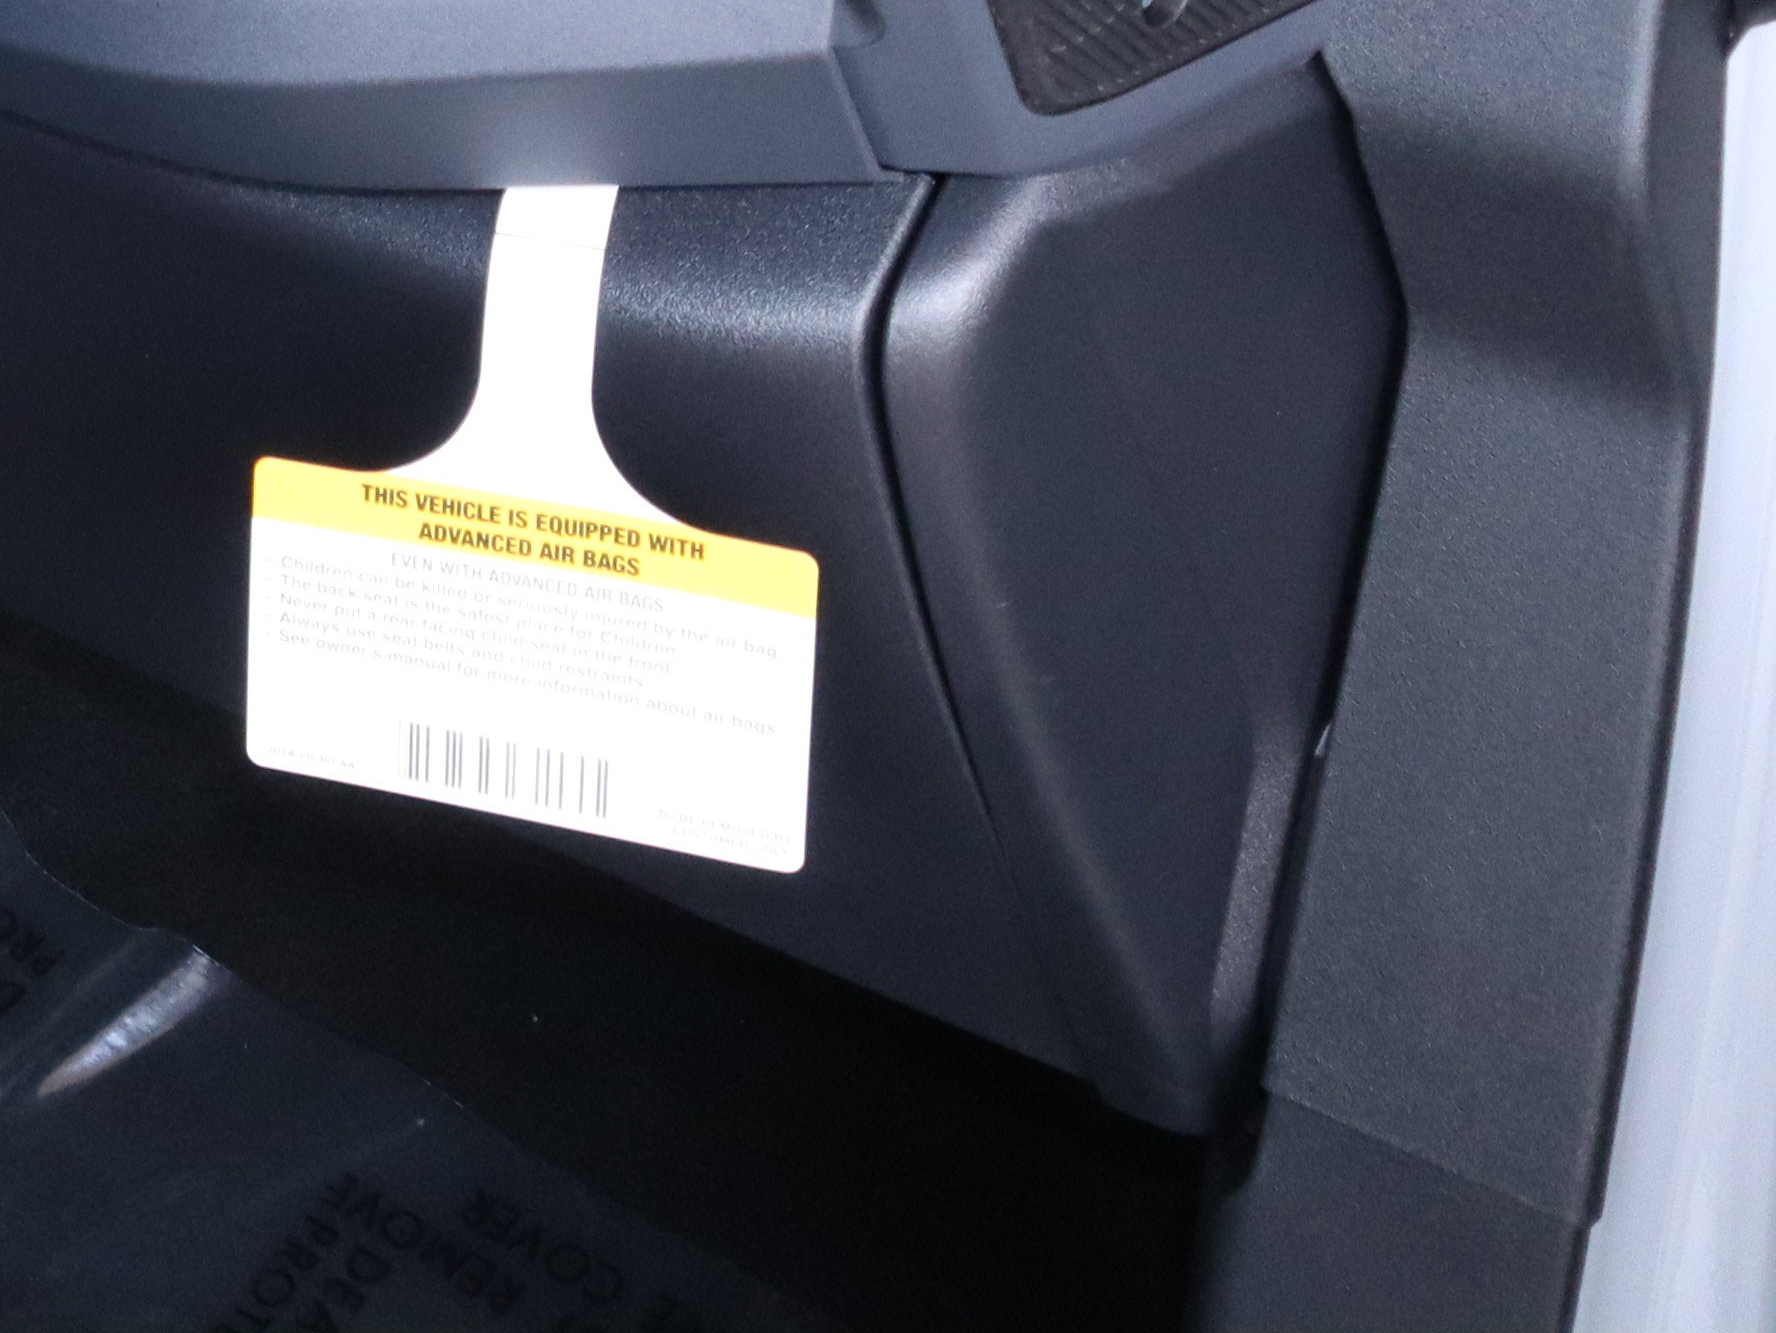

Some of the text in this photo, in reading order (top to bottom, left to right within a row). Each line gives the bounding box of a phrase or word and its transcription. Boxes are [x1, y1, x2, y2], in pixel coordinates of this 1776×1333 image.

[360, 483, 706, 562] THIS VEHICLE IS EQUIPPED WITH
[418, 520, 642, 578] ADVANCED AIR BAGS
[279, 553, 353, 580] Children
[357, 569, 391, 585] can
[393, 572, 417, 591] be
[420, 577, 469, 601] killed
[473, 591, 491, 605] or
[653, 619, 677, 640] by
[679, 624, 710, 644] the
[714, 632, 737, 650] air
[743, 637, 778, 661] bag
[279, 573, 312, 593] The
[315, 578, 359, 600] back
[362, 586, 400, 607] seat
[404, 594, 419, 611] is
[423, 597, 452, 617] the
[457, 601, 512, 628] safest
[568, 621, 595, 641] for
[390, 550, 665, 614] EVEN WITH ADVANCED AIR BAGS
[279, 593, 331, 615] Never
[334, 604, 363, 623] put
[382, 613, 417, 630] rear
[421, 616, 476, 644] facing
[529, 635, 567, 656] seat
[627, 652, 672, 676] front
[279, 610, 344, 638] Always
[348, 623, 378, 639] use
[382, 628, 419, 648] seat
[423, 632, 465, 657] belts
[470, 645, 505, 665] and
[279, 630, 310, 648] See
[386, 646, 452, 674] manual
[455, 661, 482, 680] for
[645, 695, 698, 722] about
[702, 707, 726, 726] air
[730, 712, 777, 738] bags
[320, 1171, 526, 1317] REMOVE
[460, 1188, 624, 1306] COVER
